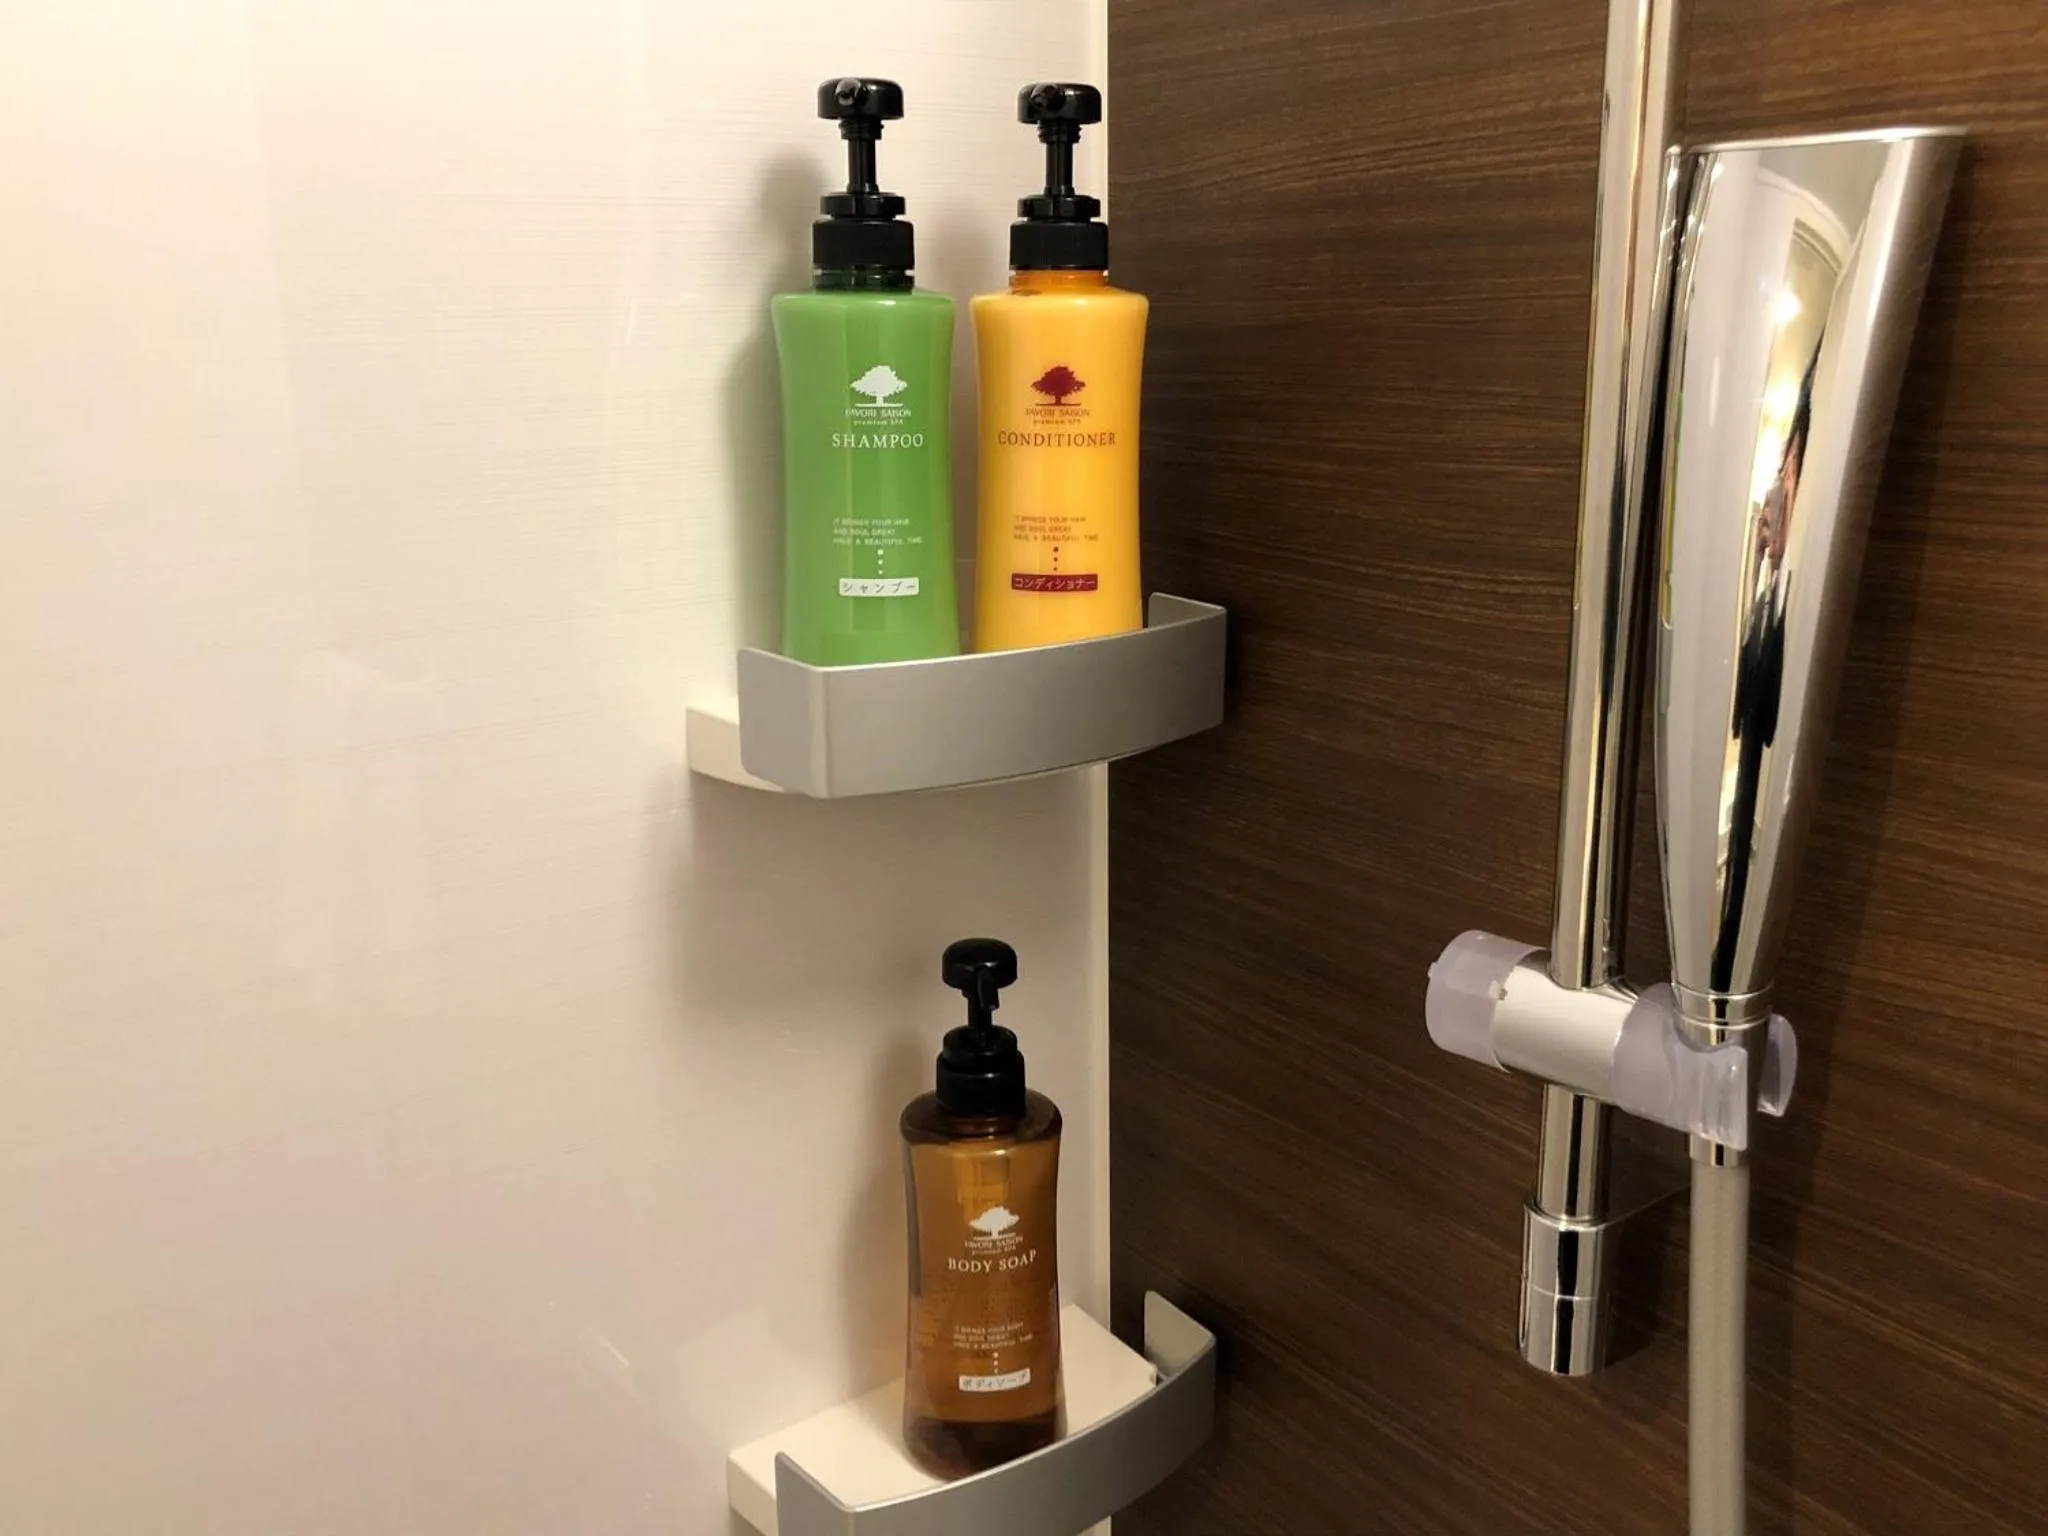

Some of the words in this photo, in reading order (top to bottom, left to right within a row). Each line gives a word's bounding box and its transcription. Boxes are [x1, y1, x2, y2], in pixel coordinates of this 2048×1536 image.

[832, 432, 924, 449] SHAMPOO
[997, 430, 1116, 448] CONDITIONER
[842, 580, 917, 594] シャンプー
[1014, 577, 1096, 590] コンディショナー
[948, 1256, 993, 1273] BODY
[998, 1248, 1037, 1271] SOAP
